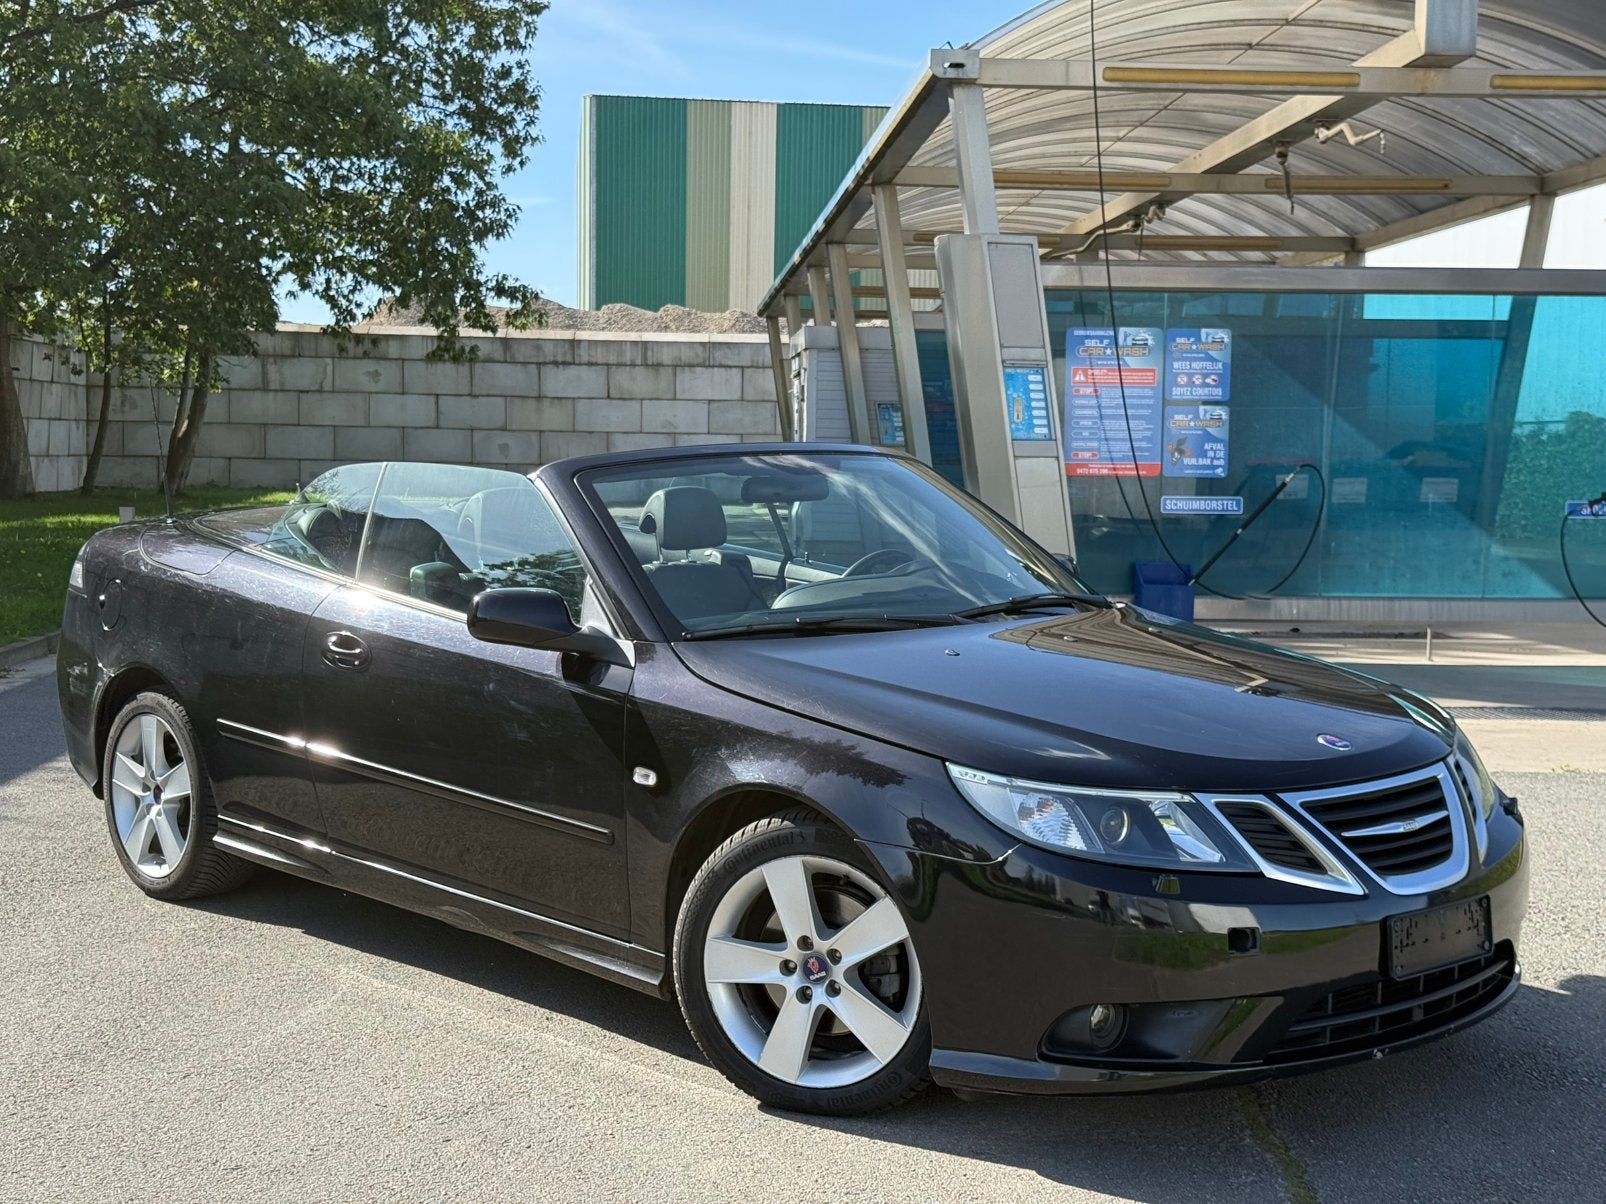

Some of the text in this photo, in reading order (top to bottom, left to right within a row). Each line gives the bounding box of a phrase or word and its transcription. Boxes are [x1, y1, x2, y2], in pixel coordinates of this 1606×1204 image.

[1084, 339, 1110, 347] SELF
[1079, 347, 1149, 356] CAR WASH
[1173, 361, 1223, 370] WEES HOFFELIJK
[1172, 387, 1223, 396] SOYEZ COURTOIS
[1183, 458, 1225, 466] VUILBAK aub
[1165, 500, 1238, 511] SCHUIMBORSTEL
[723, 831, 794, 874] Continental
